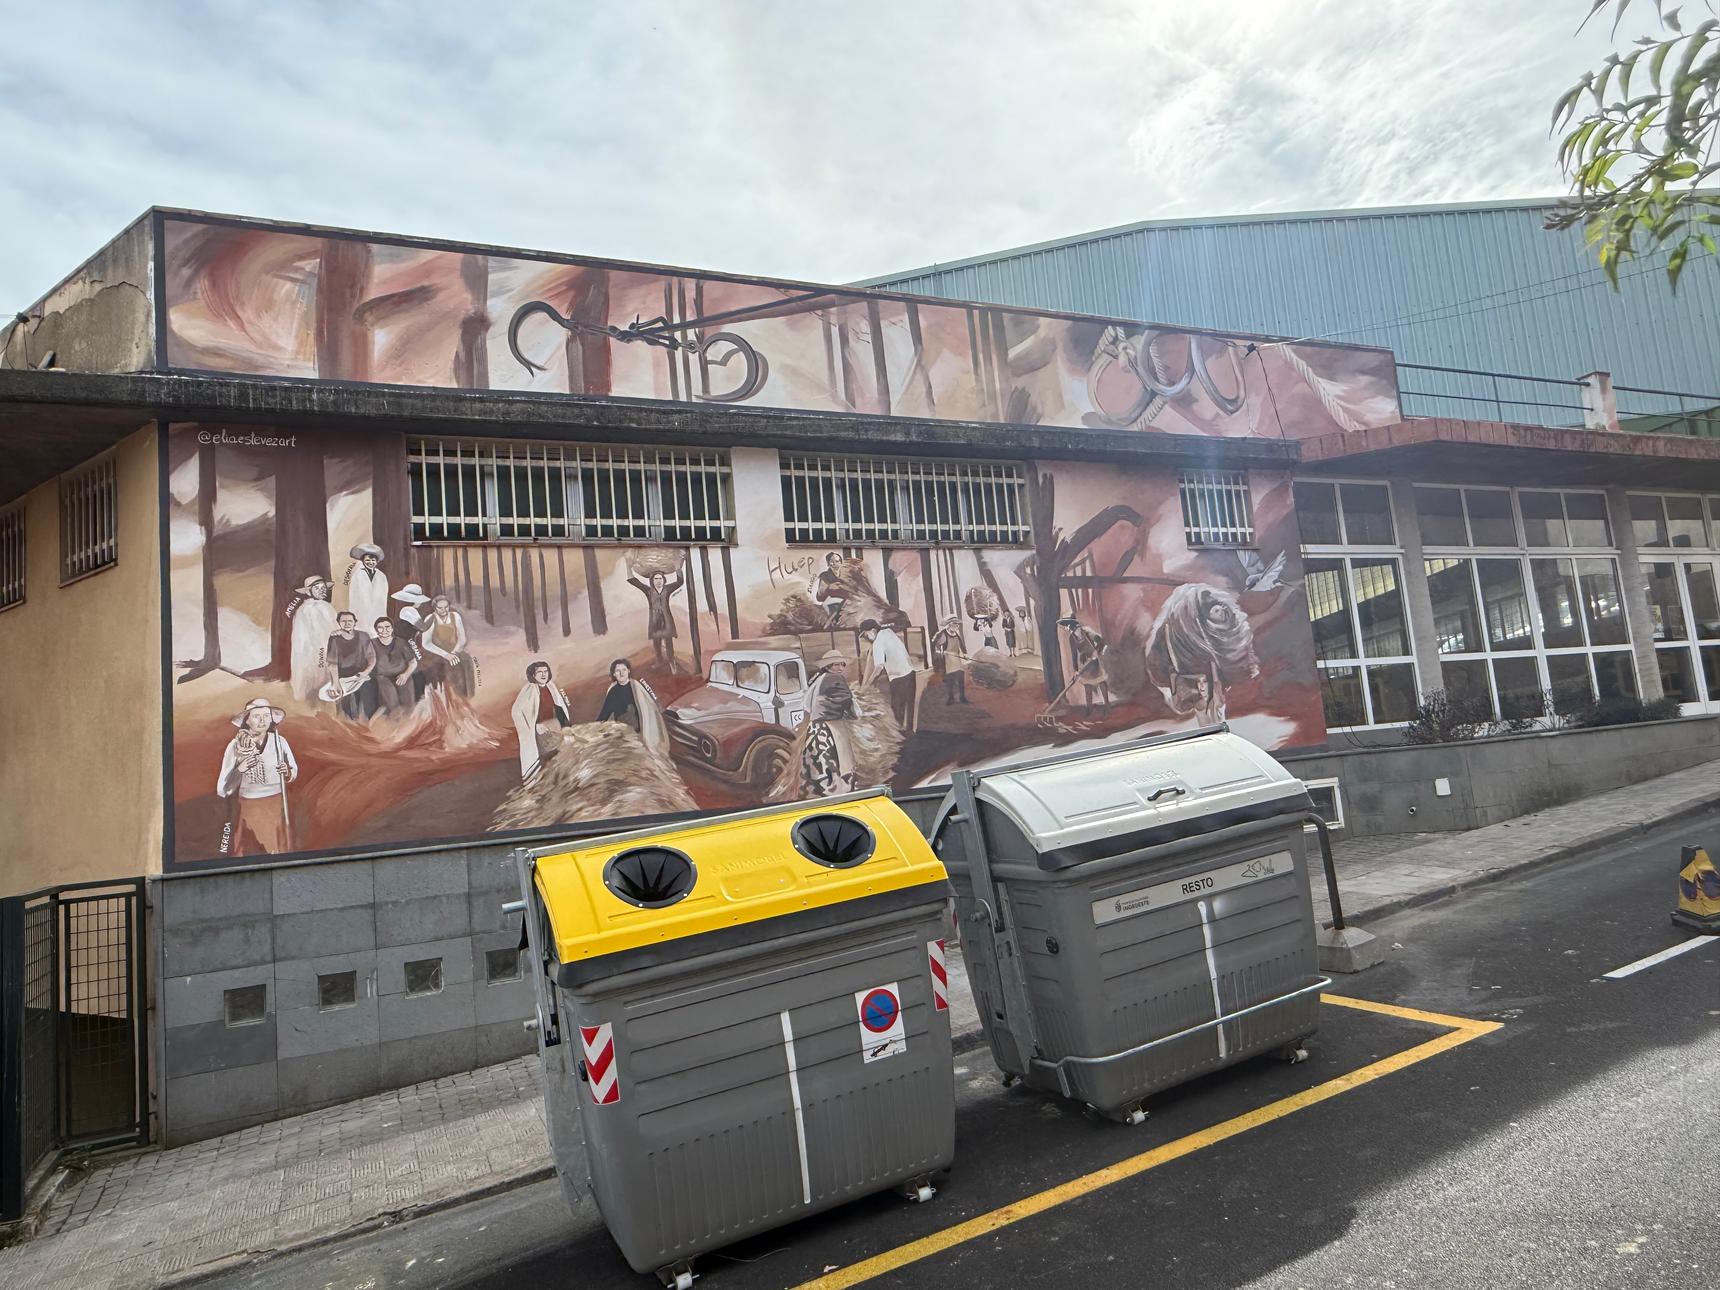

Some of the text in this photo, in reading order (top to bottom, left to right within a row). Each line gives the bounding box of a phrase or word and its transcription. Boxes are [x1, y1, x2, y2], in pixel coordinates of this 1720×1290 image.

[198, 428, 296, 447] @eliaestevezart
[284, 597, 301, 618] AMELIA
[219, 822, 232, 853] NEREIDA
[1181, 877, 1214, 895] RESTO
